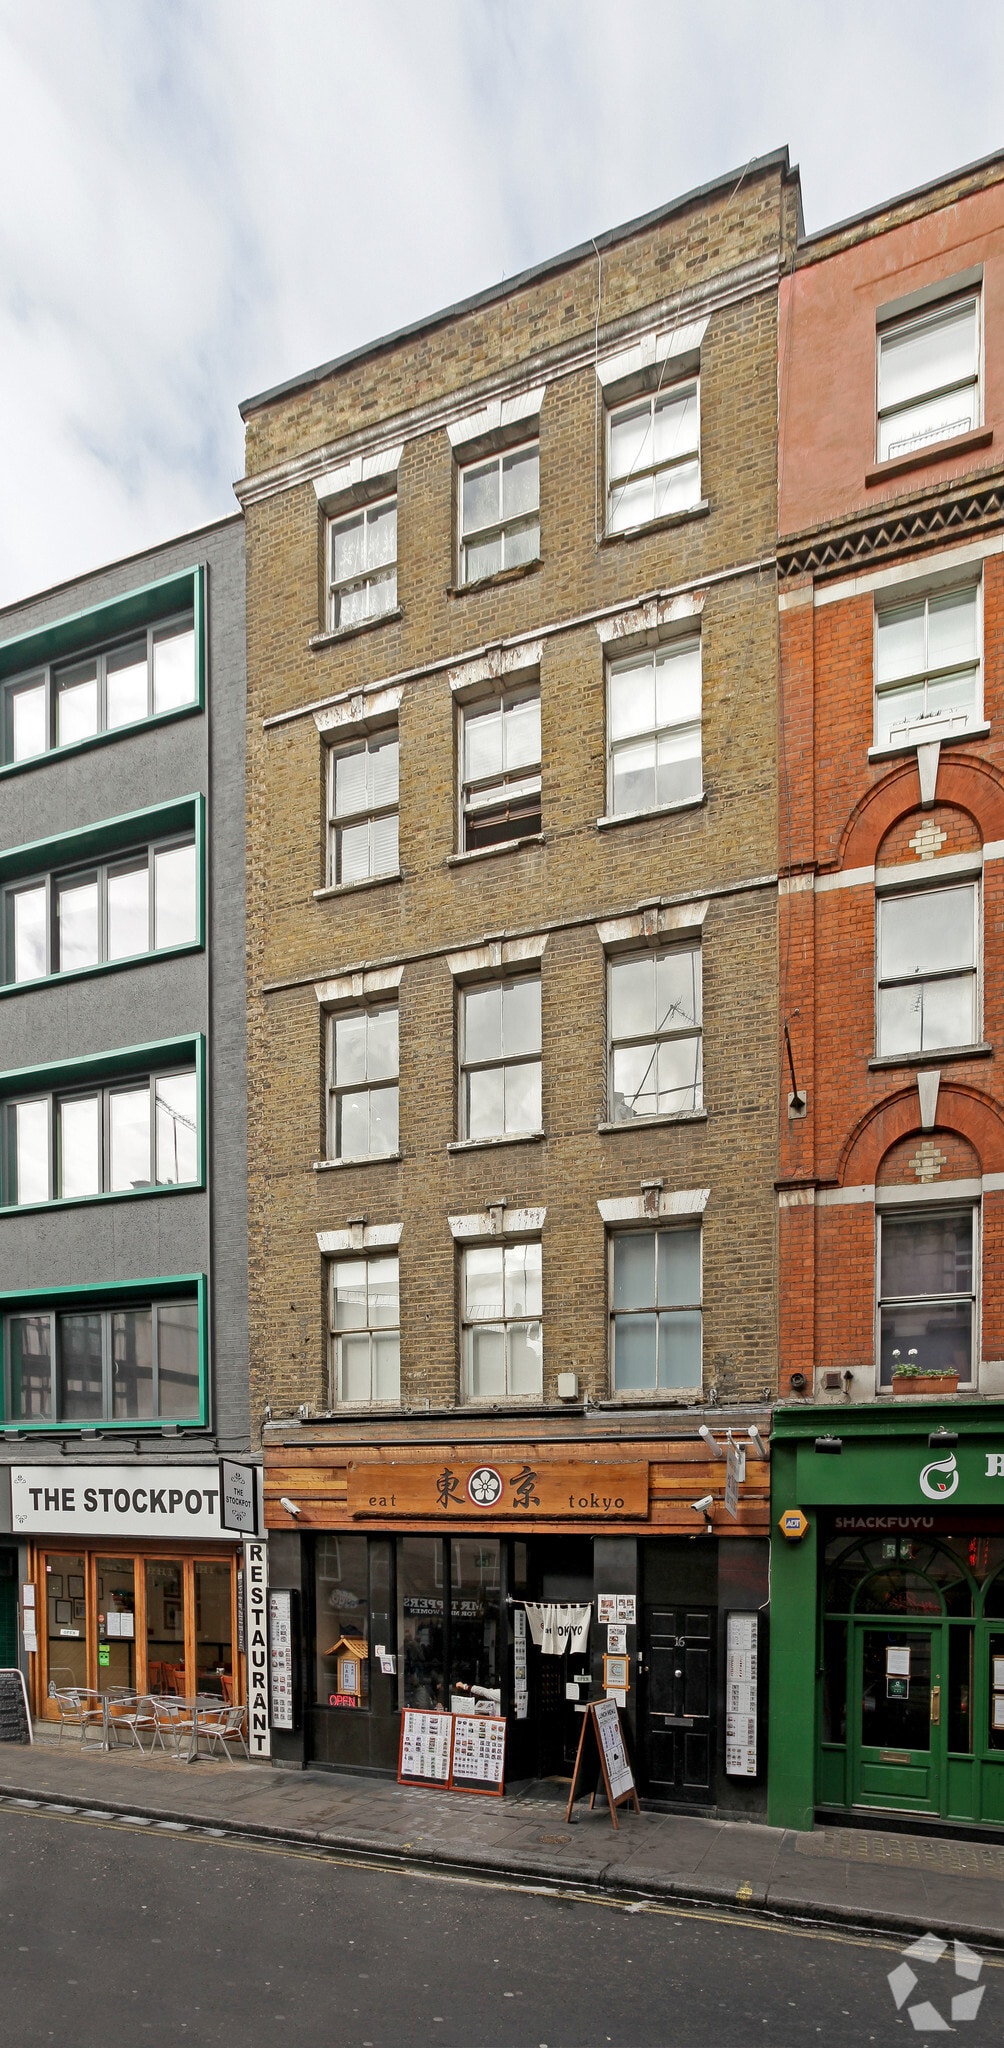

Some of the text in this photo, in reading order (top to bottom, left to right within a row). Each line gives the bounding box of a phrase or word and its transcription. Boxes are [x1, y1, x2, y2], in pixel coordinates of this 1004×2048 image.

[233, 1487, 244, 1497] THE
[436, 1465, 541, 1509] 東 京
[29, 1488, 219, 1515] THE STOCKPOT
[225, 1495, 252, 1508] STOCKPOT
[368, 1494, 397, 1507] eat
[568, 1492, 626, 1511] tokyo
[785, 1518, 801, 1528] ADT
[835, 1516, 934, 1528] SHACKFUYU
[249, 1544, 267, 1752] RESTAURANT
[674, 1636, 686, 1647] 16
[329, 1694, 356, 1708] OPEN
